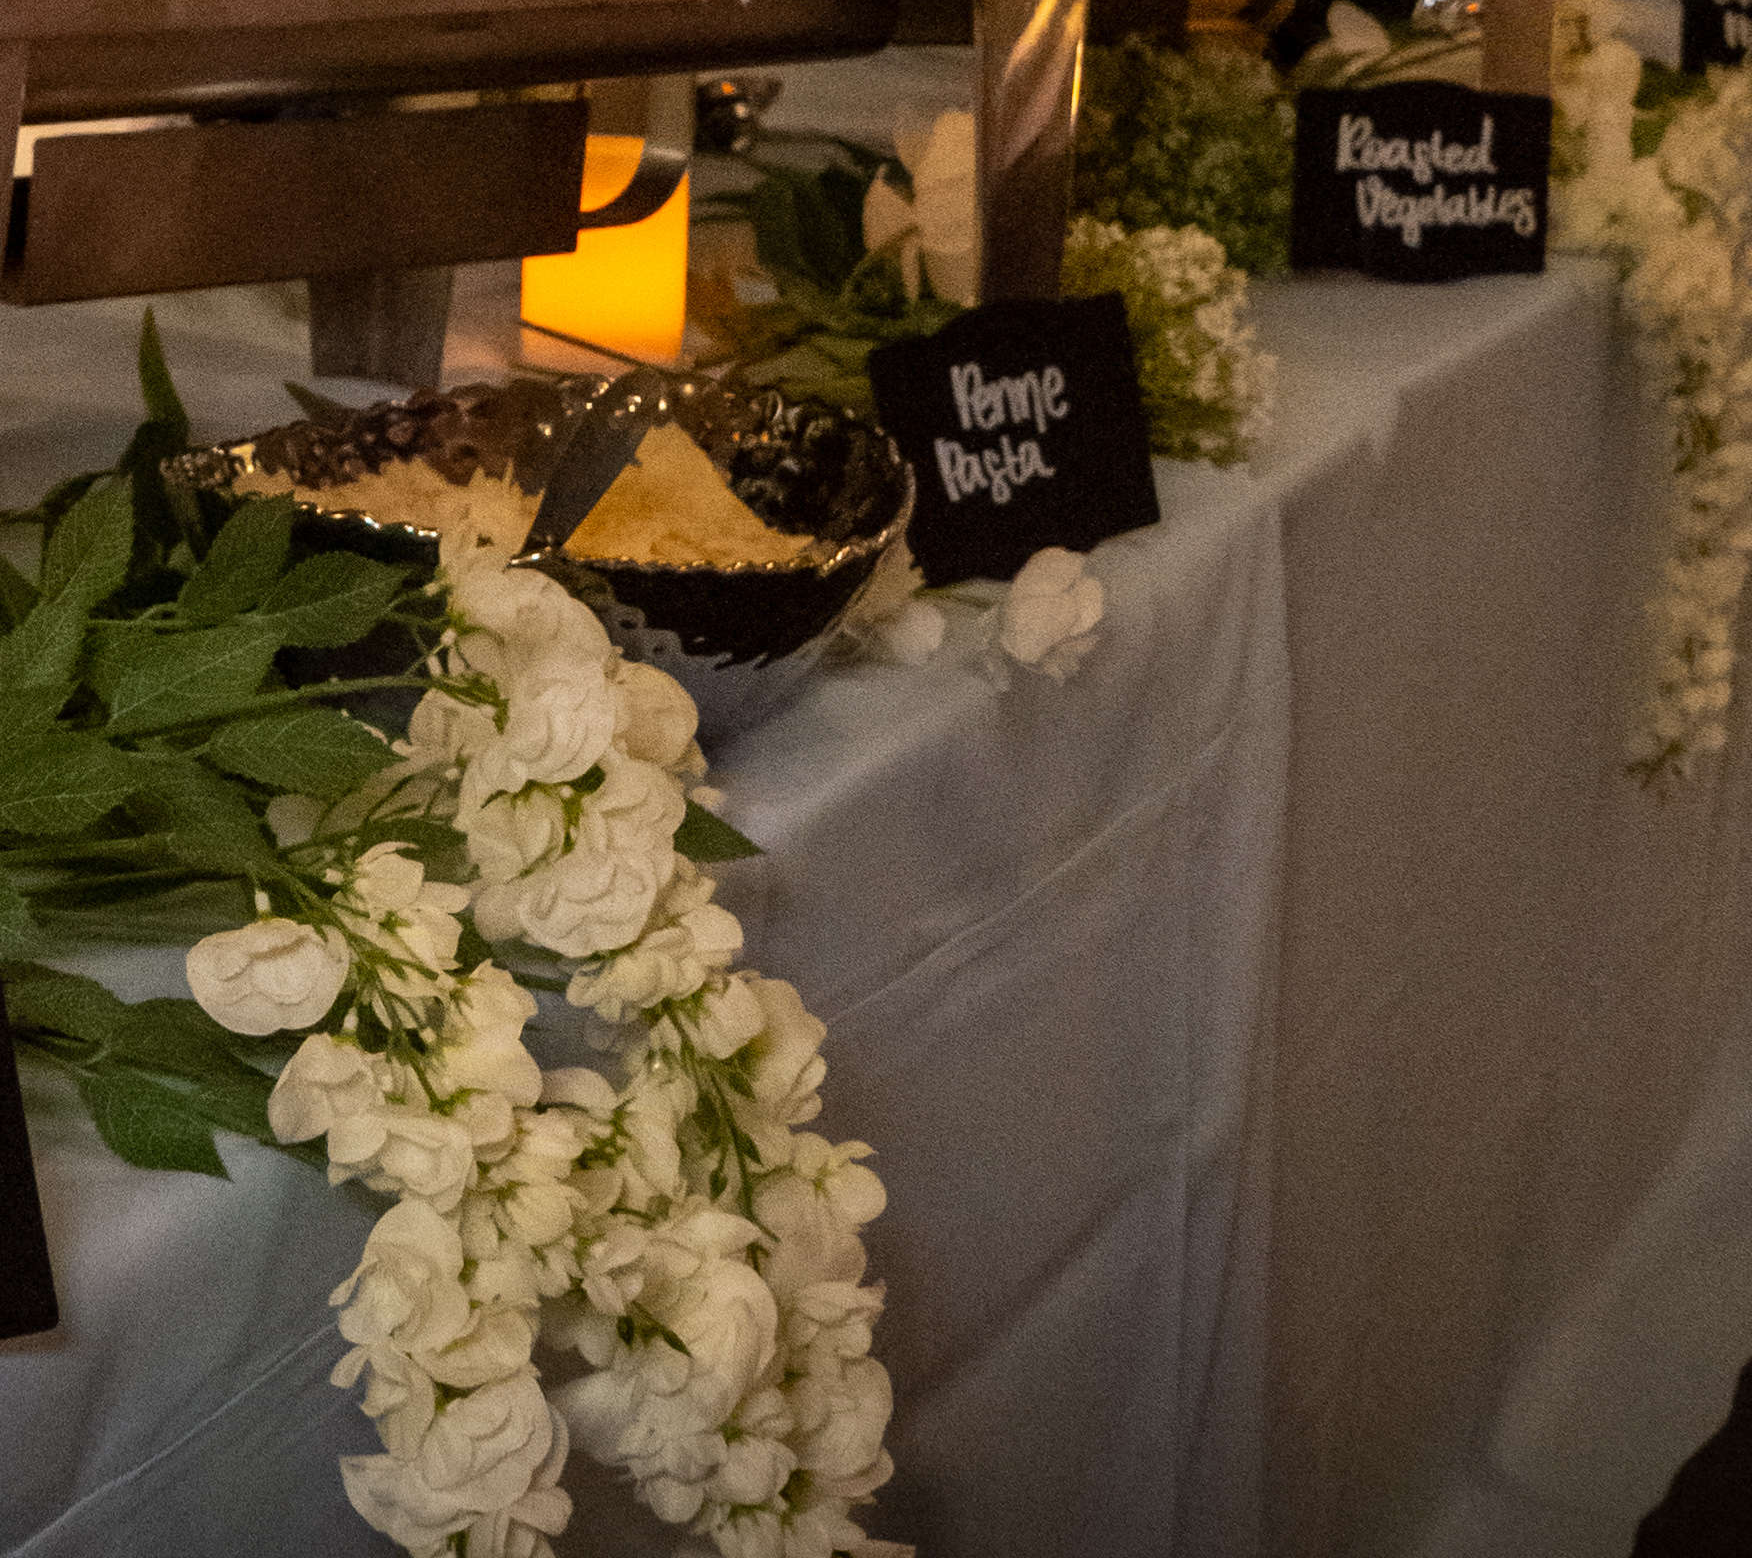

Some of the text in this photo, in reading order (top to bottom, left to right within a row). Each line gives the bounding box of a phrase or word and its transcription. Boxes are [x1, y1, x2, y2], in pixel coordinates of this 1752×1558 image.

[1336, 113, 1496, 184] Roasted
[1355, 175, 1537, 248] Vegetables
[950, 361, 1069, 433] Penne
[934, 435, 1056, 504] Pasta
